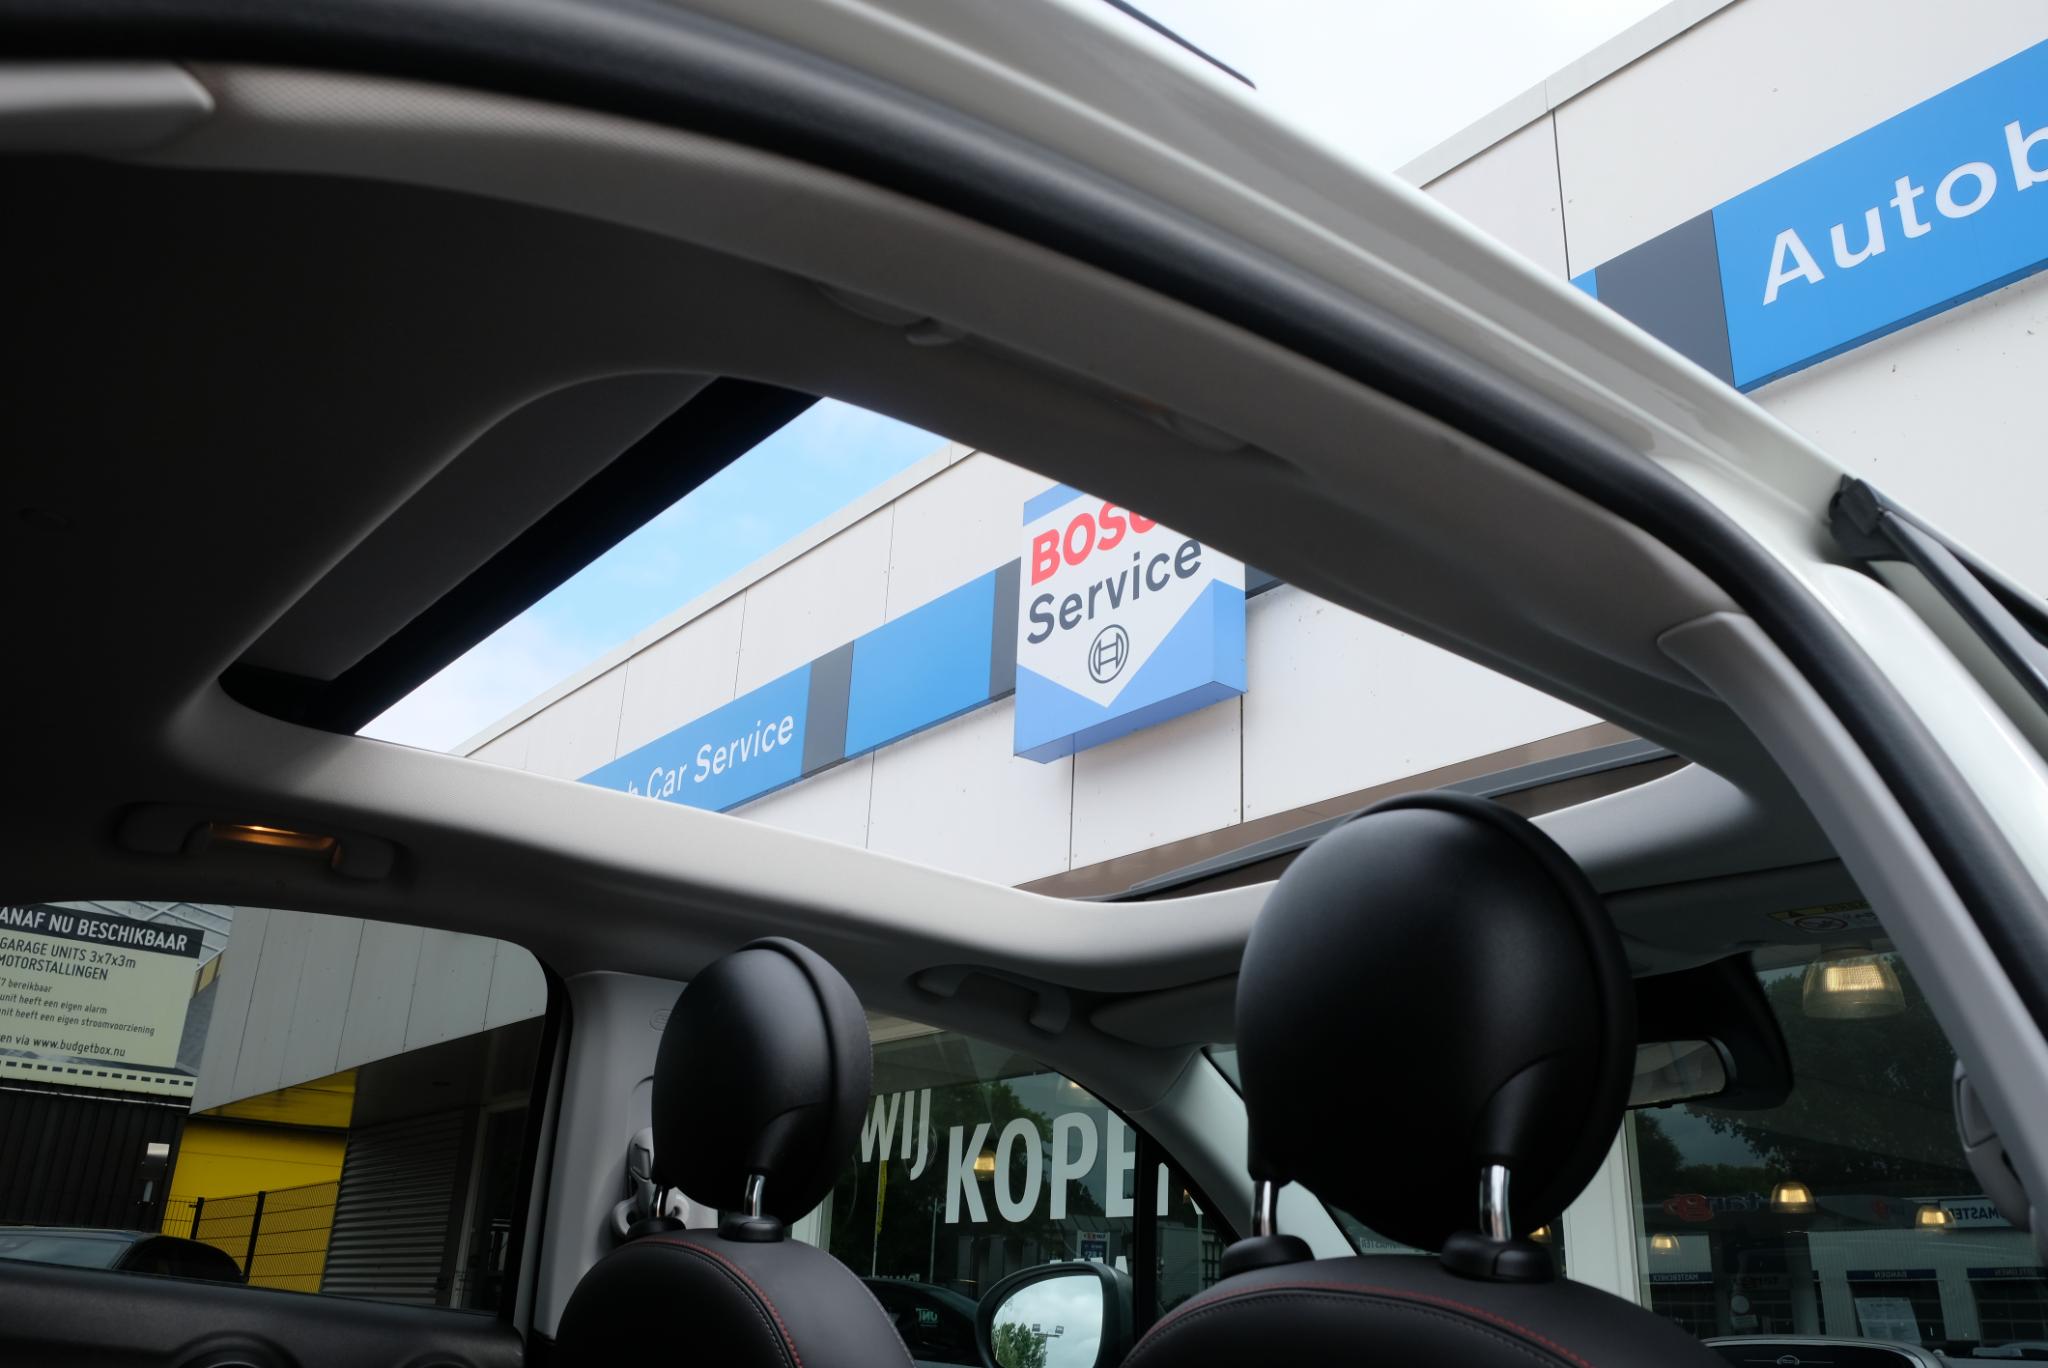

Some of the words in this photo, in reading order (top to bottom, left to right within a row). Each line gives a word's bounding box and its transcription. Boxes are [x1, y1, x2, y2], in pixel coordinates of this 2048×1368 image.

[1027, 538, 1202, 645] Service
[646, 763, 688, 800] Car
[693, 714, 795, 783] Service
[49, 913, 74, 934] NU
[77, 919, 188, 952] BESCHIKBAAR
[0, 936, 48, 956] GARAGE
[51, 944, 87, 962] UNITS
[90, 951, 137, 969] 3x7x3m
[8, 979, 53, 994] bereikbaar
[19, 995, 42, 1007] heeft
[43, 1001, 59, 1010] een
[60, 1002, 83, 1014] eigen
[84, 1004, 108, 1015] alarm
[15, 1008, 39, 1021] heeft
[40, 1014, 55, 1024] een
[57, 1016, 79, 1028] eigen
[81, 1018, 156, 1037] stroomvoorziening
[15, 1034, 30, 1046] via
[33, 1037, 126, 1058] www.budgetbox.nu
[861, 1088, 932, 1181] WIJ
